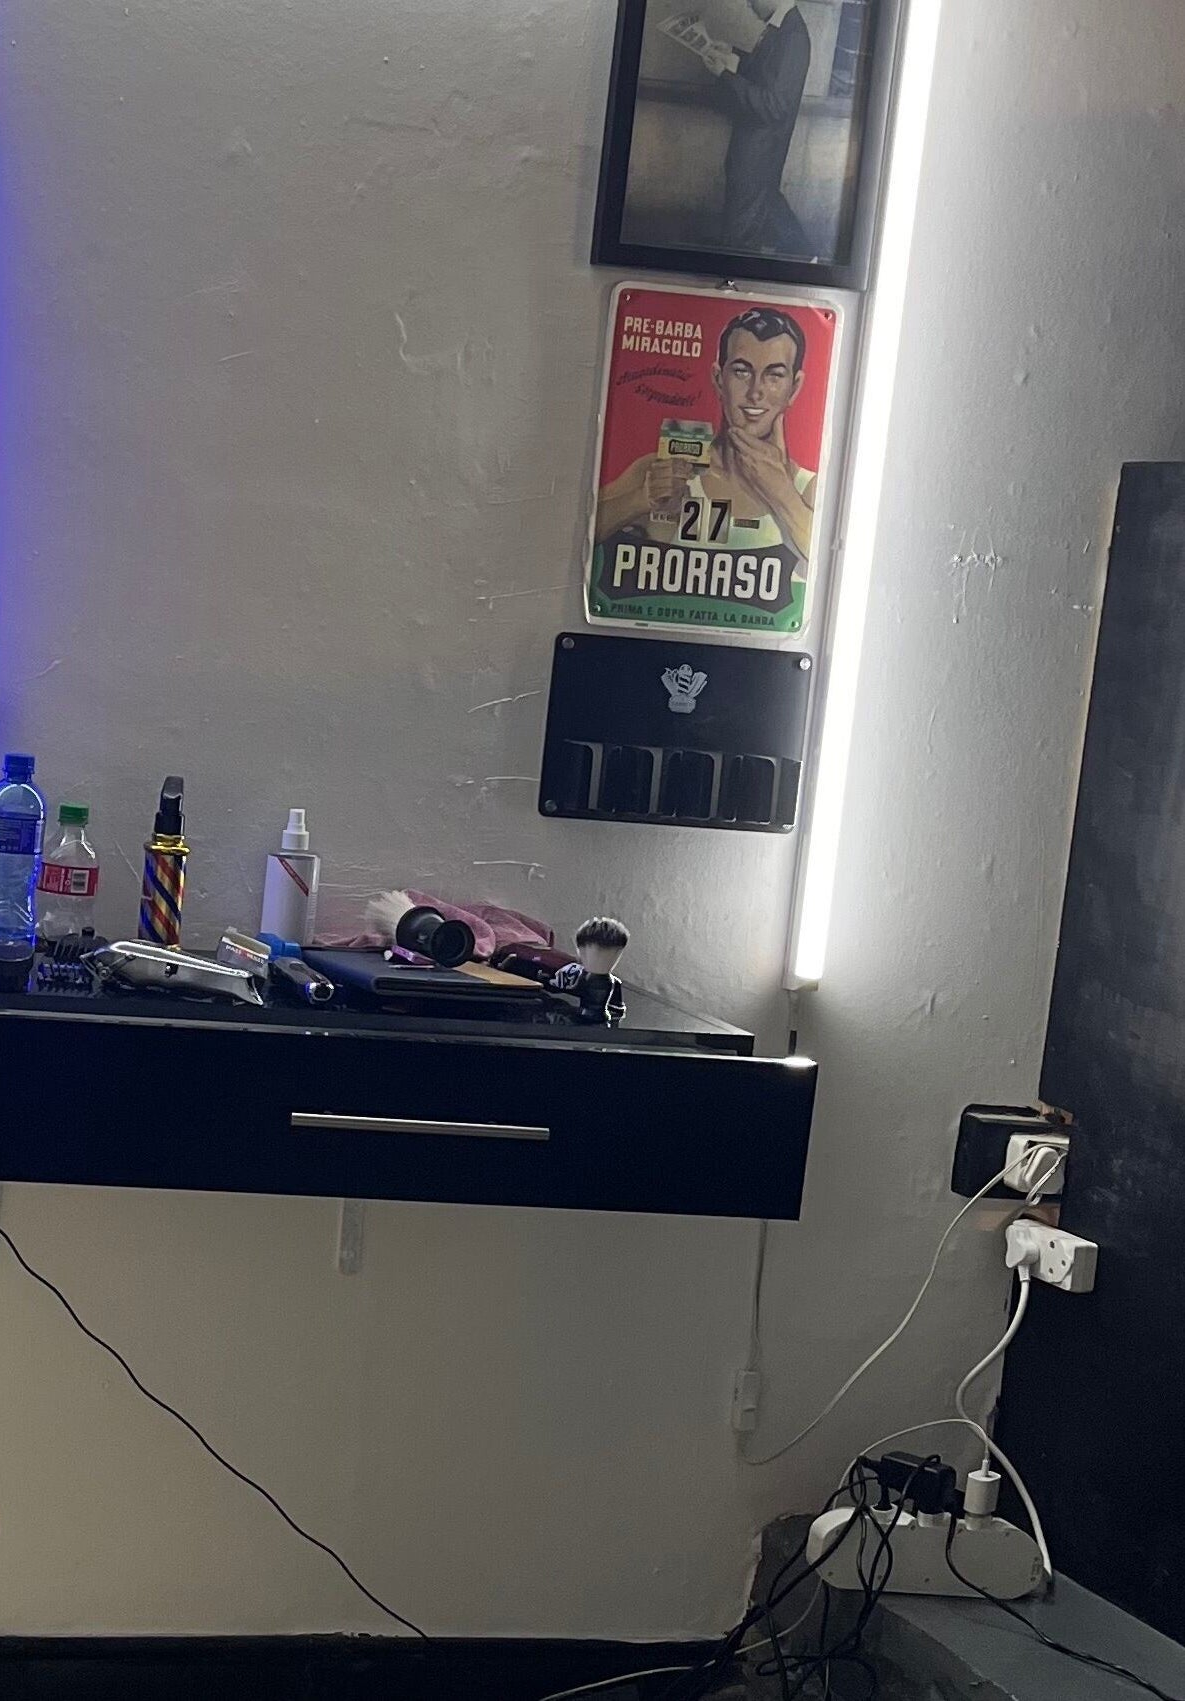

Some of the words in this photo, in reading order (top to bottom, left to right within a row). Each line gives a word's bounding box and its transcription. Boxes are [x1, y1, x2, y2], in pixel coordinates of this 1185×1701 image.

[624, 316, 702, 339] PRE-BARBA
[622, 334, 702, 357] MIRACOLO
[613, 544, 782, 601] PRORASO
[610, 603, 643, 615] PRIMA
[647, 606, 653, 616] E
[689, 609, 720, 622] FATTA
[724, 613, 737, 623] LA
[741, 614, 775, 626] BARBA
